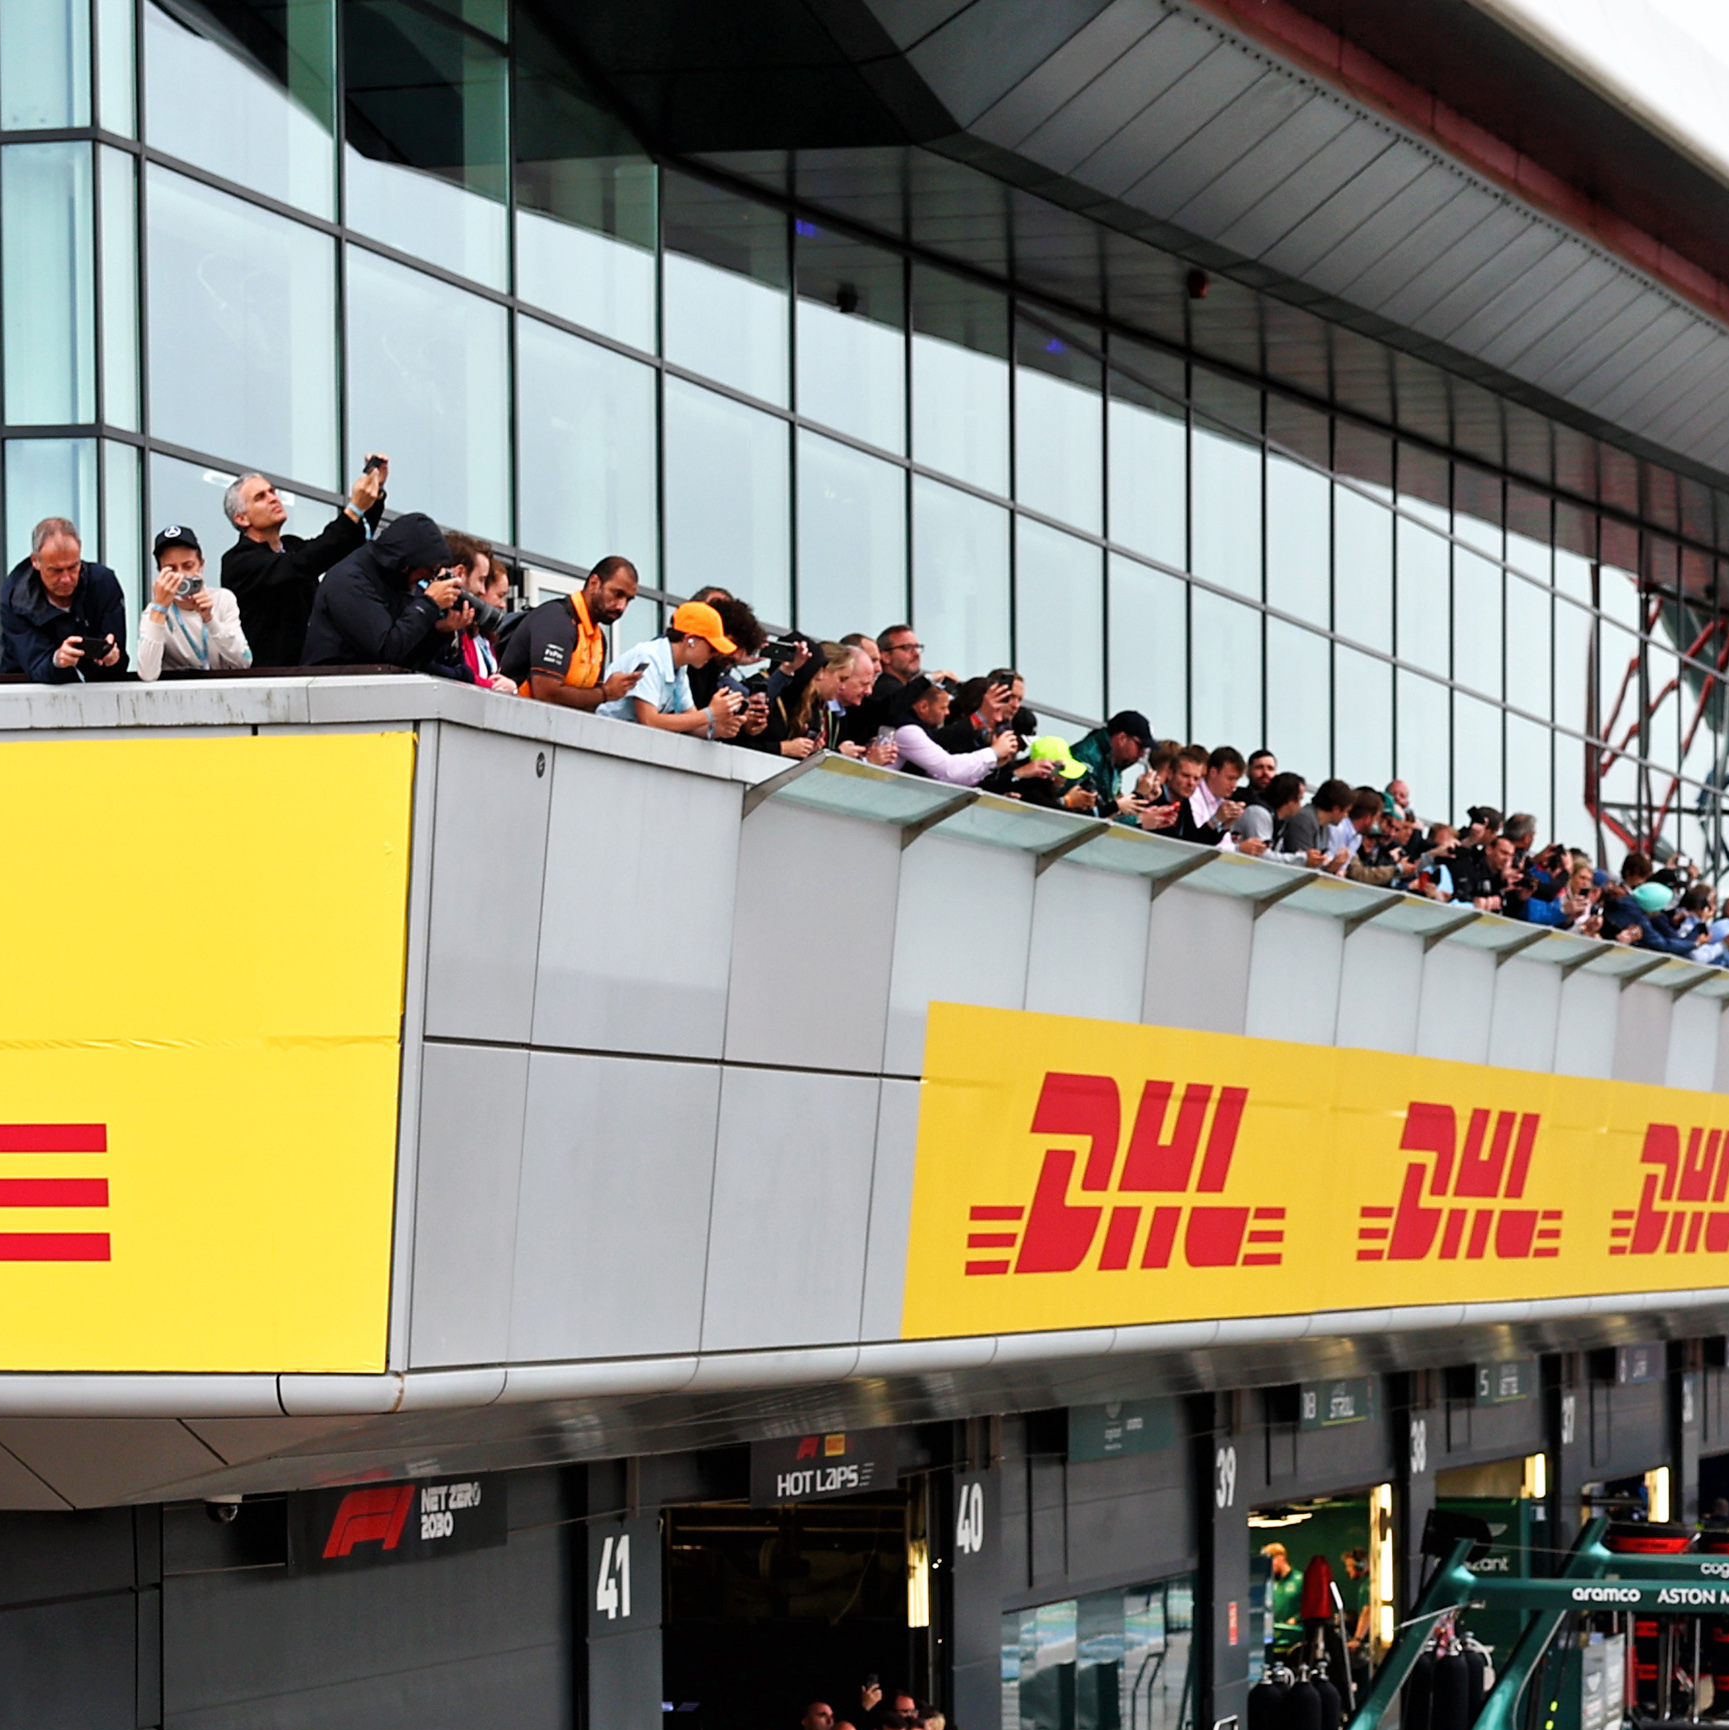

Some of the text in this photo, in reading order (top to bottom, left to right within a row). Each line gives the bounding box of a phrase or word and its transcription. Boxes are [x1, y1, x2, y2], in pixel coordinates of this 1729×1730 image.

[1014, 1071, 1249, 1275] DHL
[1387, 1100, 1541, 1261] DHL
[1302, 1391, 1318, 1419] 18
[420, 1483, 449, 1514] NET
[776, 1469, 815, 1498] HOT
[1216, 1446, 1237, 1508] 39
[420, 1511, 455, 1542] 2030
[956, 1483, 984, 1555] 40
[595, 1533, 631, 1621] 41
[1571, 1586, 1642, 1603] aramco
[1657, 1588, 1718, 1605] ASTON
